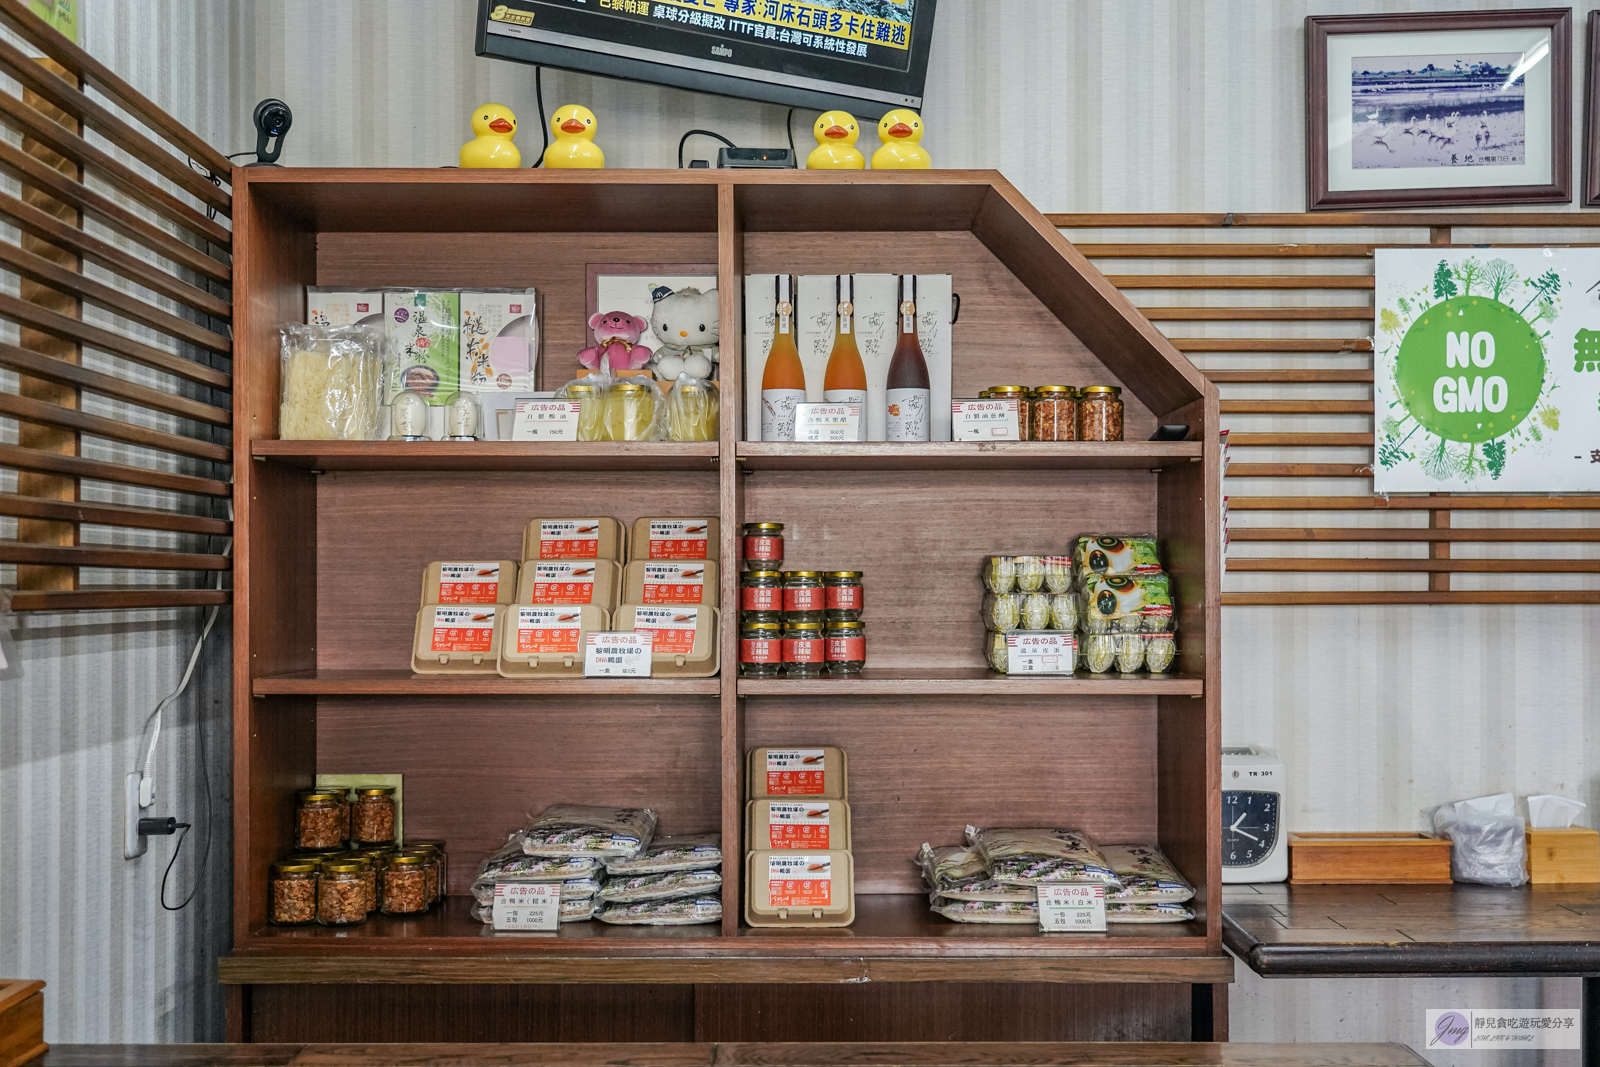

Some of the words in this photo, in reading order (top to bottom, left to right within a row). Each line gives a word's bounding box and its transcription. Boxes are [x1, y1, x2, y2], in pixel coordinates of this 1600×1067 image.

[652, 4, 725, 30] 桌球分級擬改
[1446, 331, 1496, 369] NO
[1432, 376, 1508, 414] GMO
[510, 887, 545, 895] 広告の品
[1054, 888, 1089, 896] 広告の品
